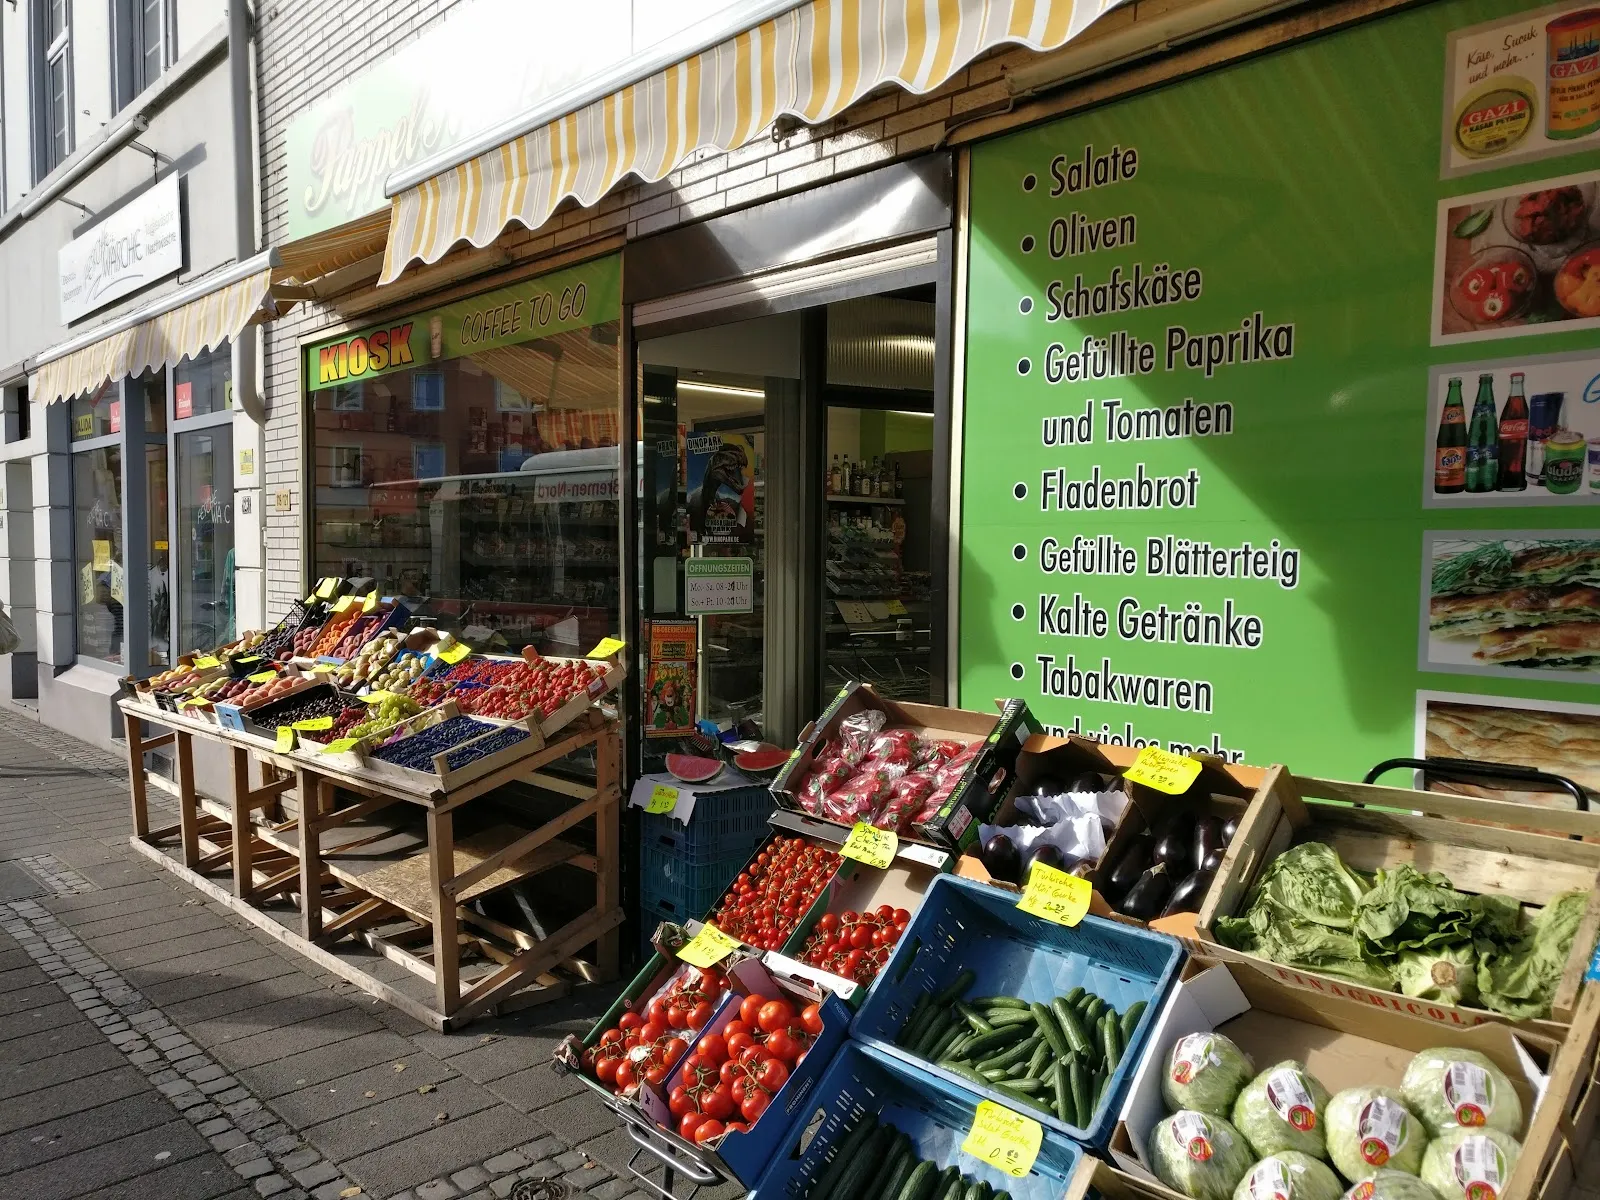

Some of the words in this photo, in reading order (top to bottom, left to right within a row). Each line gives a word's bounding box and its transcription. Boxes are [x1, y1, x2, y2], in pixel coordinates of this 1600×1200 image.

[1469, 66, 1488, 84] und
[1469, 100, 1520, 125] GAZI
[1050, 145, 1137, 197] Salate
[1049, 212, 1136, 259] Oliven
[461, 301, 523, 346] COFFEE
[529, 292, 552, 329] TO
[558, 282, 587, 321] GO
[1045, 263, 1201, 322] Schafskäse
[319, 322, 414, 385] KIOSK
[1044, 331, 1154, 384] Gefüllte
[1165, 311, 1295, 378] Paprika
[687, 436, 723, 449] DINOPARK
[1042, 400, 1094, 447] und
[1101, 398, 1233, 443] Tomaten
[1040, 463, 1200, 511] Fladenbrot
[1040, 535, 1137, 575] Gefüllte
[1146, 535, 1300, 590] Blätterteig
[735, 596, 748, 606] Uhr
[1038, 592, 1108, 637] Kalte
[1117, 597, 1263, 650] Getränke
[1036, 654, 1213, 714] Tabakwaren
